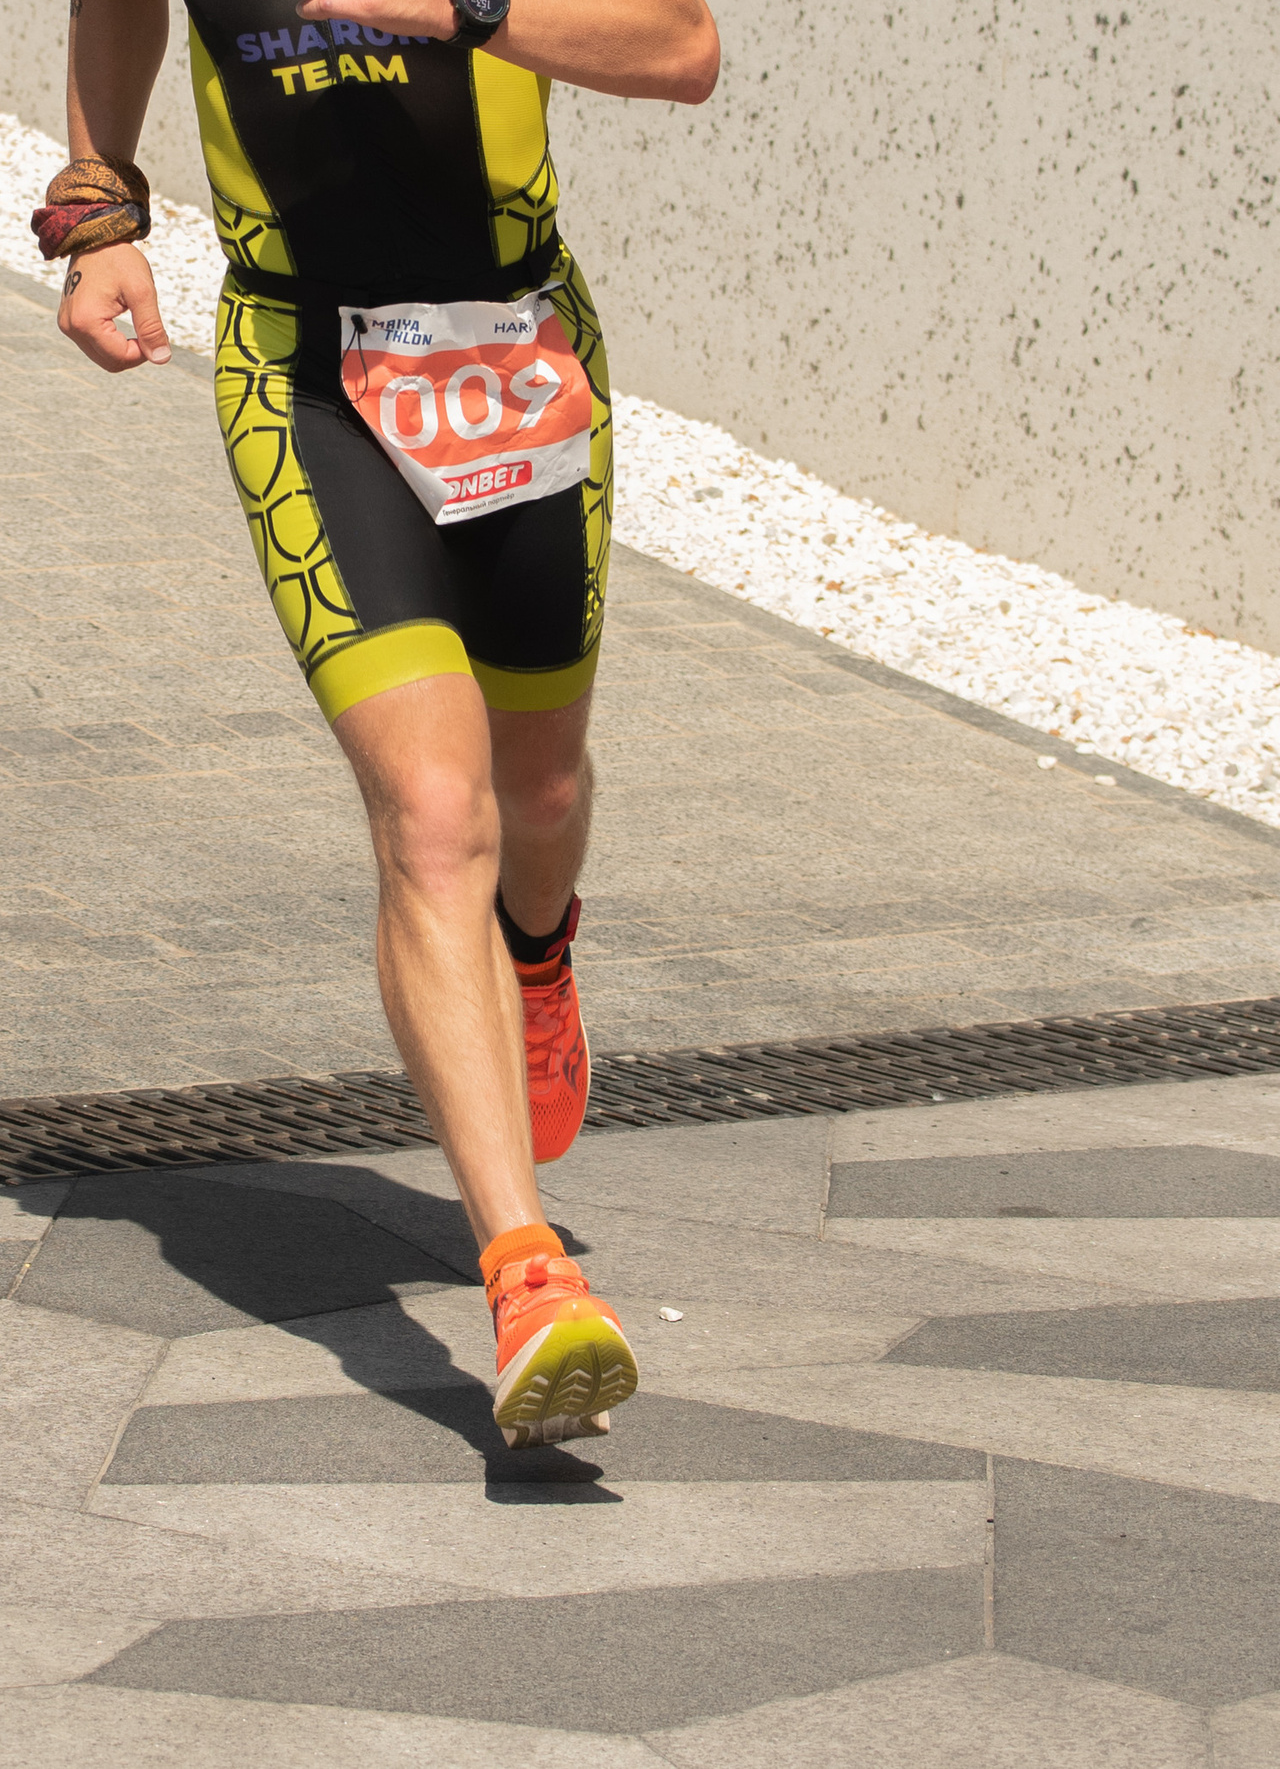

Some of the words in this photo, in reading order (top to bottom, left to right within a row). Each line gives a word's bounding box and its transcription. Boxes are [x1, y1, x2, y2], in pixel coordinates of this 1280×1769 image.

[272, 54, 409, 96] TEAM
[372, 319, 419, 332] MAIYA
[380, 359, 562, 450] 009
[446, 464, 525, 500] ONBET
[442, 500, 487, 517] Генеральный
[488, 492, 515, 509] партнёр
